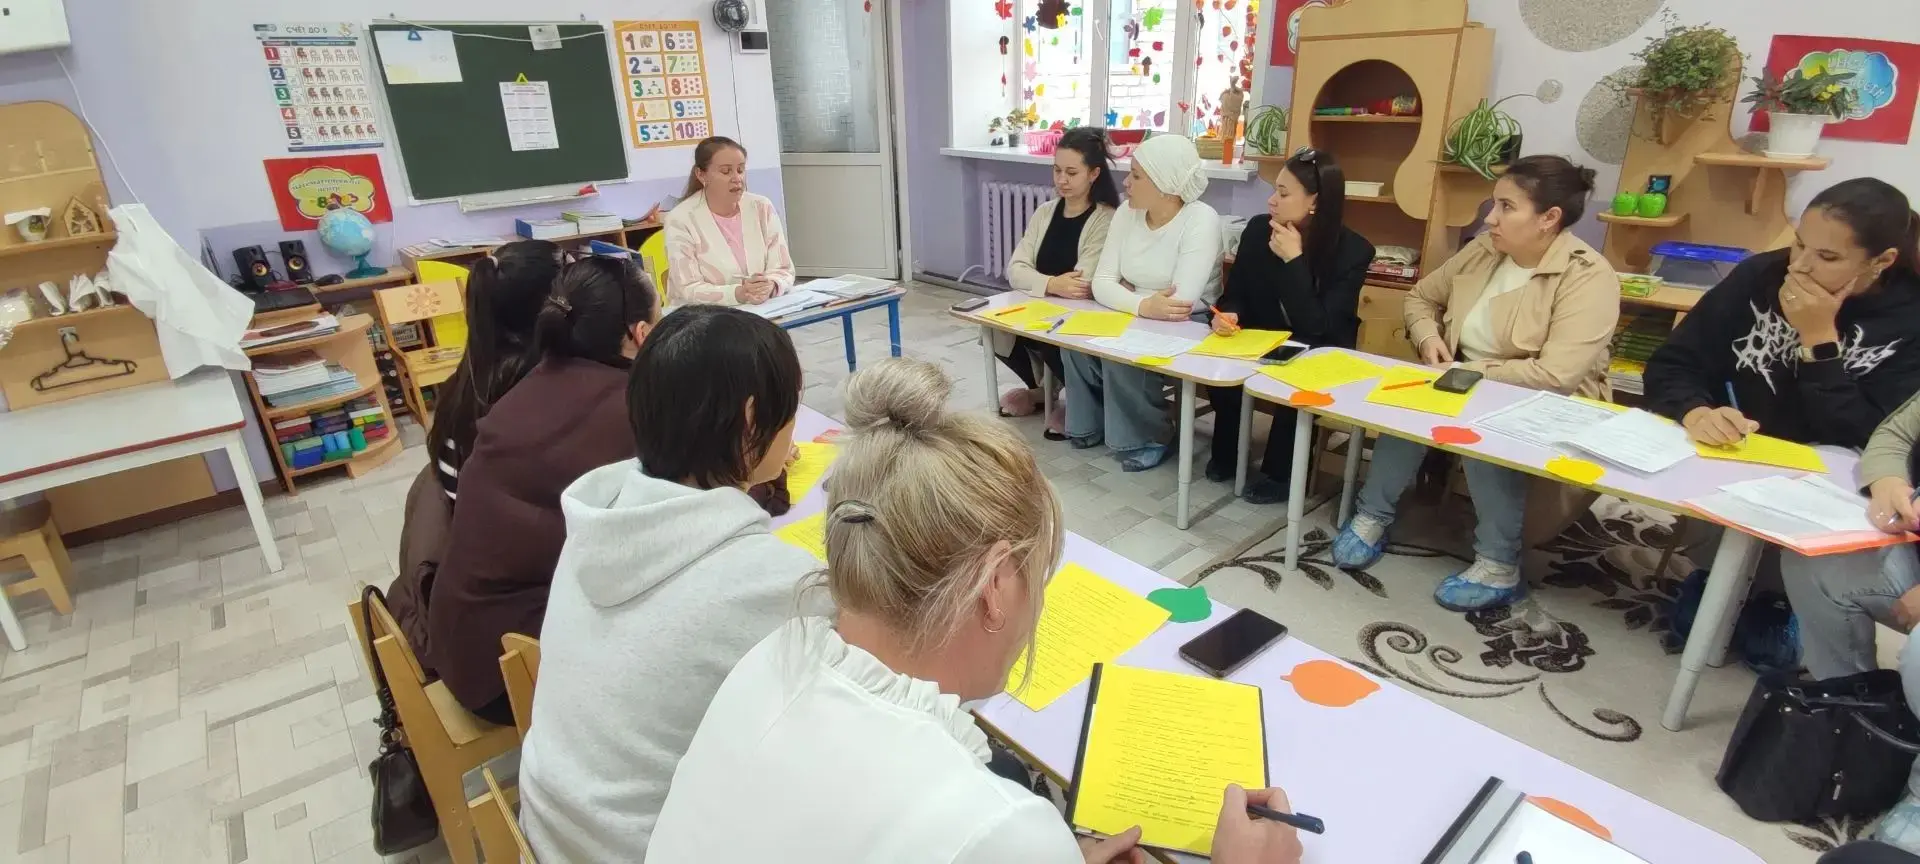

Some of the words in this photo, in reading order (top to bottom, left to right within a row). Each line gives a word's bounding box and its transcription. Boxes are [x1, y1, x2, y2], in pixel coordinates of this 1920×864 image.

[625, 33, 636, 51] 1
[664, 32, 676, 51] 6
[628, 56, 641, 75] 2
[667, 55, 678, 73] 7
[272, 68, 282, 79] 2
[279, 88, 288, 99] 3
[633, 79, 644, 97] 3
[671, 78, 682, 96] 8
[283, 108, 294, 118] 4
[636, 102, 649, 120] 4
[674, 100, 685, 118] 9
[290, 127, 299, 138] 5
[639, 124, 651, 142] 5
[675, 121, 695, 139] 10
